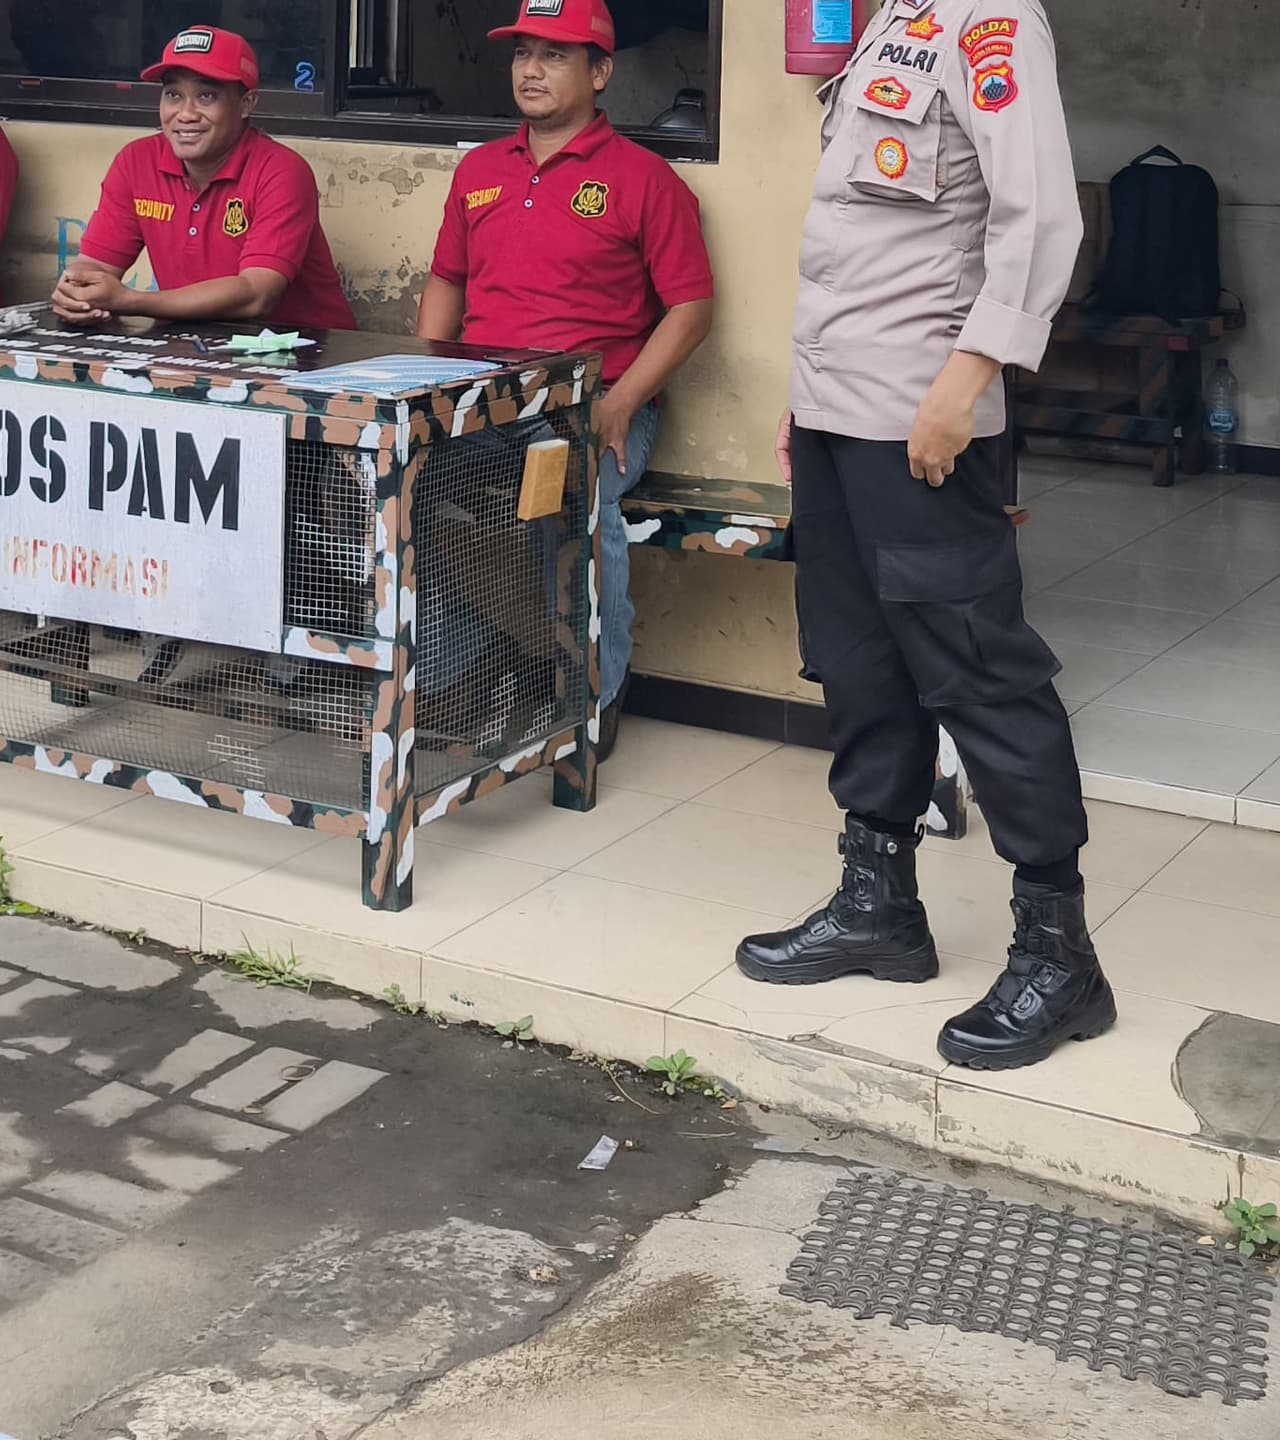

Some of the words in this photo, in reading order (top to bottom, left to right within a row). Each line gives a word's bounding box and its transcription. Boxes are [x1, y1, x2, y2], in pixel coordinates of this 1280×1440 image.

[963, 20, 1011, 47] POLDA
[877, 42, 938, 74] POLRI
[294, 62, 316, 91] 2
[133, 198, 175, 222] ECURITY
[465, 185, 503, 210] SECURITY
[88, 421, 241, 531] PAM
[3, 533, 169, 599] INFORMASI
